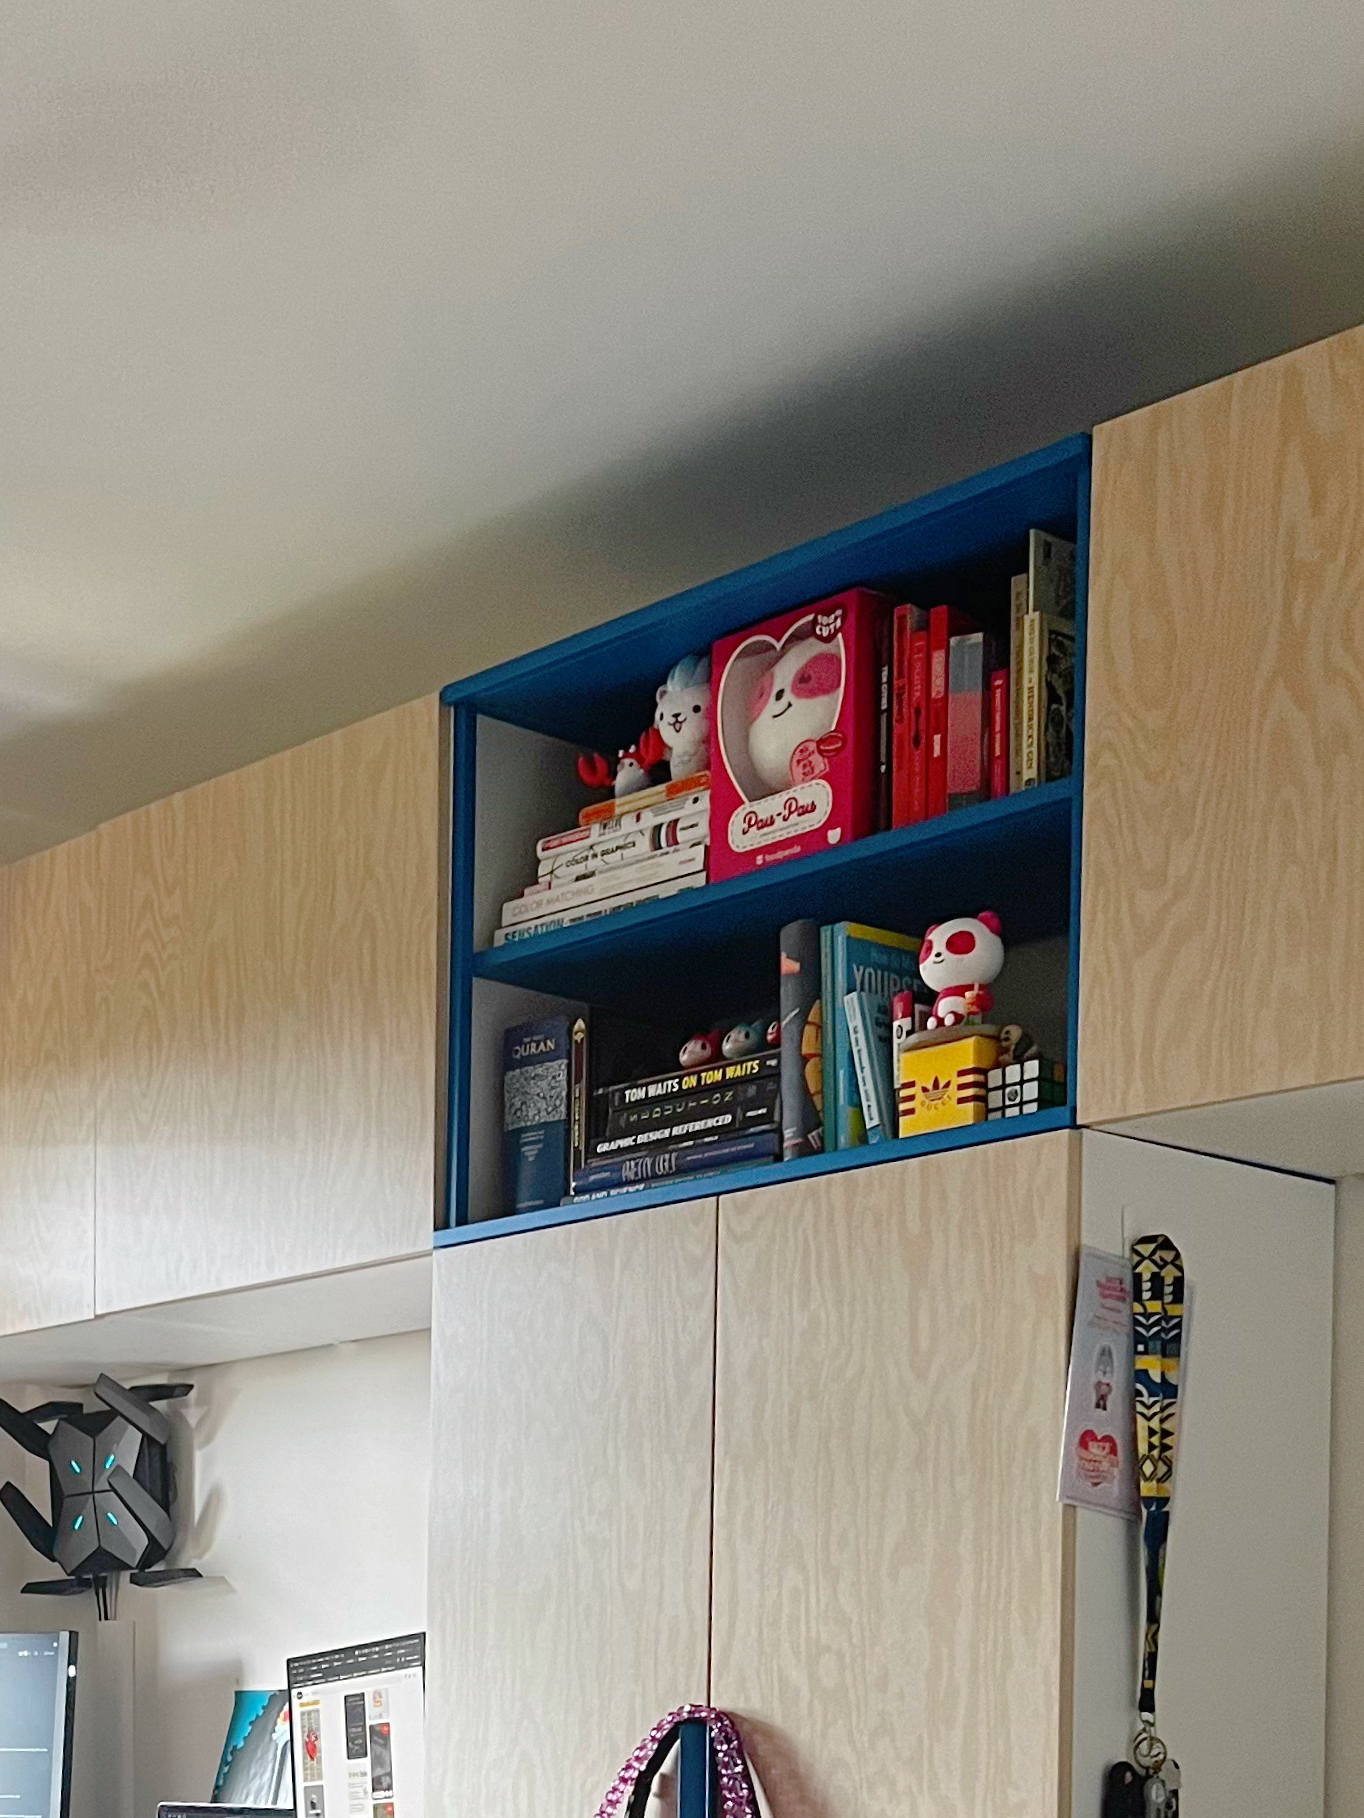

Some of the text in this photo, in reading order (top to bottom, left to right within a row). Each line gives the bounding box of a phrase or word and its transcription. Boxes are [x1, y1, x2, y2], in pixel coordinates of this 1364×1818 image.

[512, 1038, 556, 1059] QURAN
[624, 1088, 647, 1104] TOM
[647, 1078, 680, 1099] WAITS
[682, 1074, 699, 1090] ON
[700, 1067, 723, 1086] TOM
[725, 1059, 760, 1080] WAITS
[596, 1135, 637, 1154] GRAPHIC
[637, 1126, 671, 1145] DESIGN
[671, 1114, 733, 1137] REFERENCED
